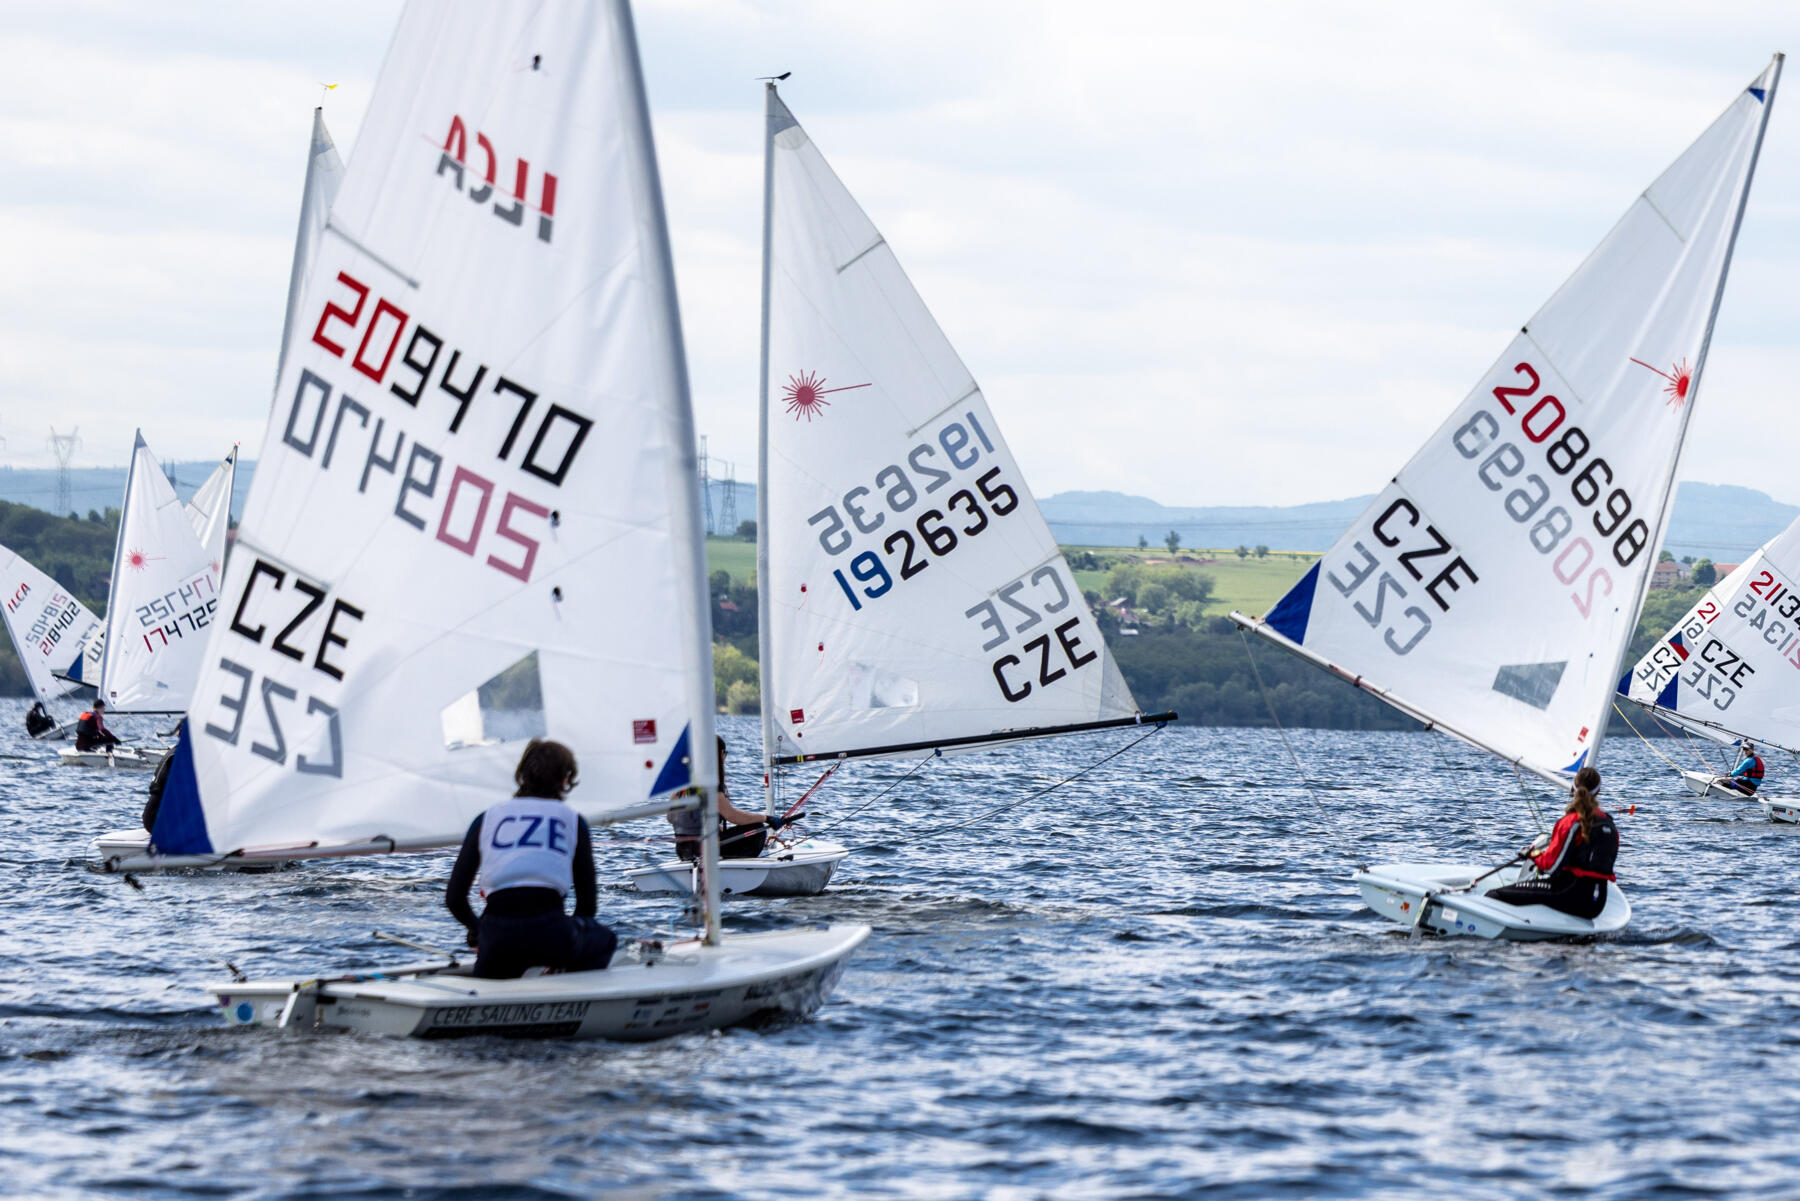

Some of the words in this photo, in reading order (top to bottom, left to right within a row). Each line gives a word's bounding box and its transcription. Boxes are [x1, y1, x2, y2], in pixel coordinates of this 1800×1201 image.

[312, 270, 595, 488] 209470
[832, 465, 1019, 612] 192635
[1372, 497, 1480, 613] CZE
[7, 582, 32, 614] ILCA
[39, 600, 81, 657] 218402
[229, 557, 366, 683] CZE
[992, 616, 1098, 703] CZE
[1700, 638, 1756, 690] CZE
[490, 815, 569, 855] CZE
[432, 1006, 476, 1026] CERE
[477, 1002, 544, 1024] SAILING
[546, 1000, 592, 1019] TEAM
